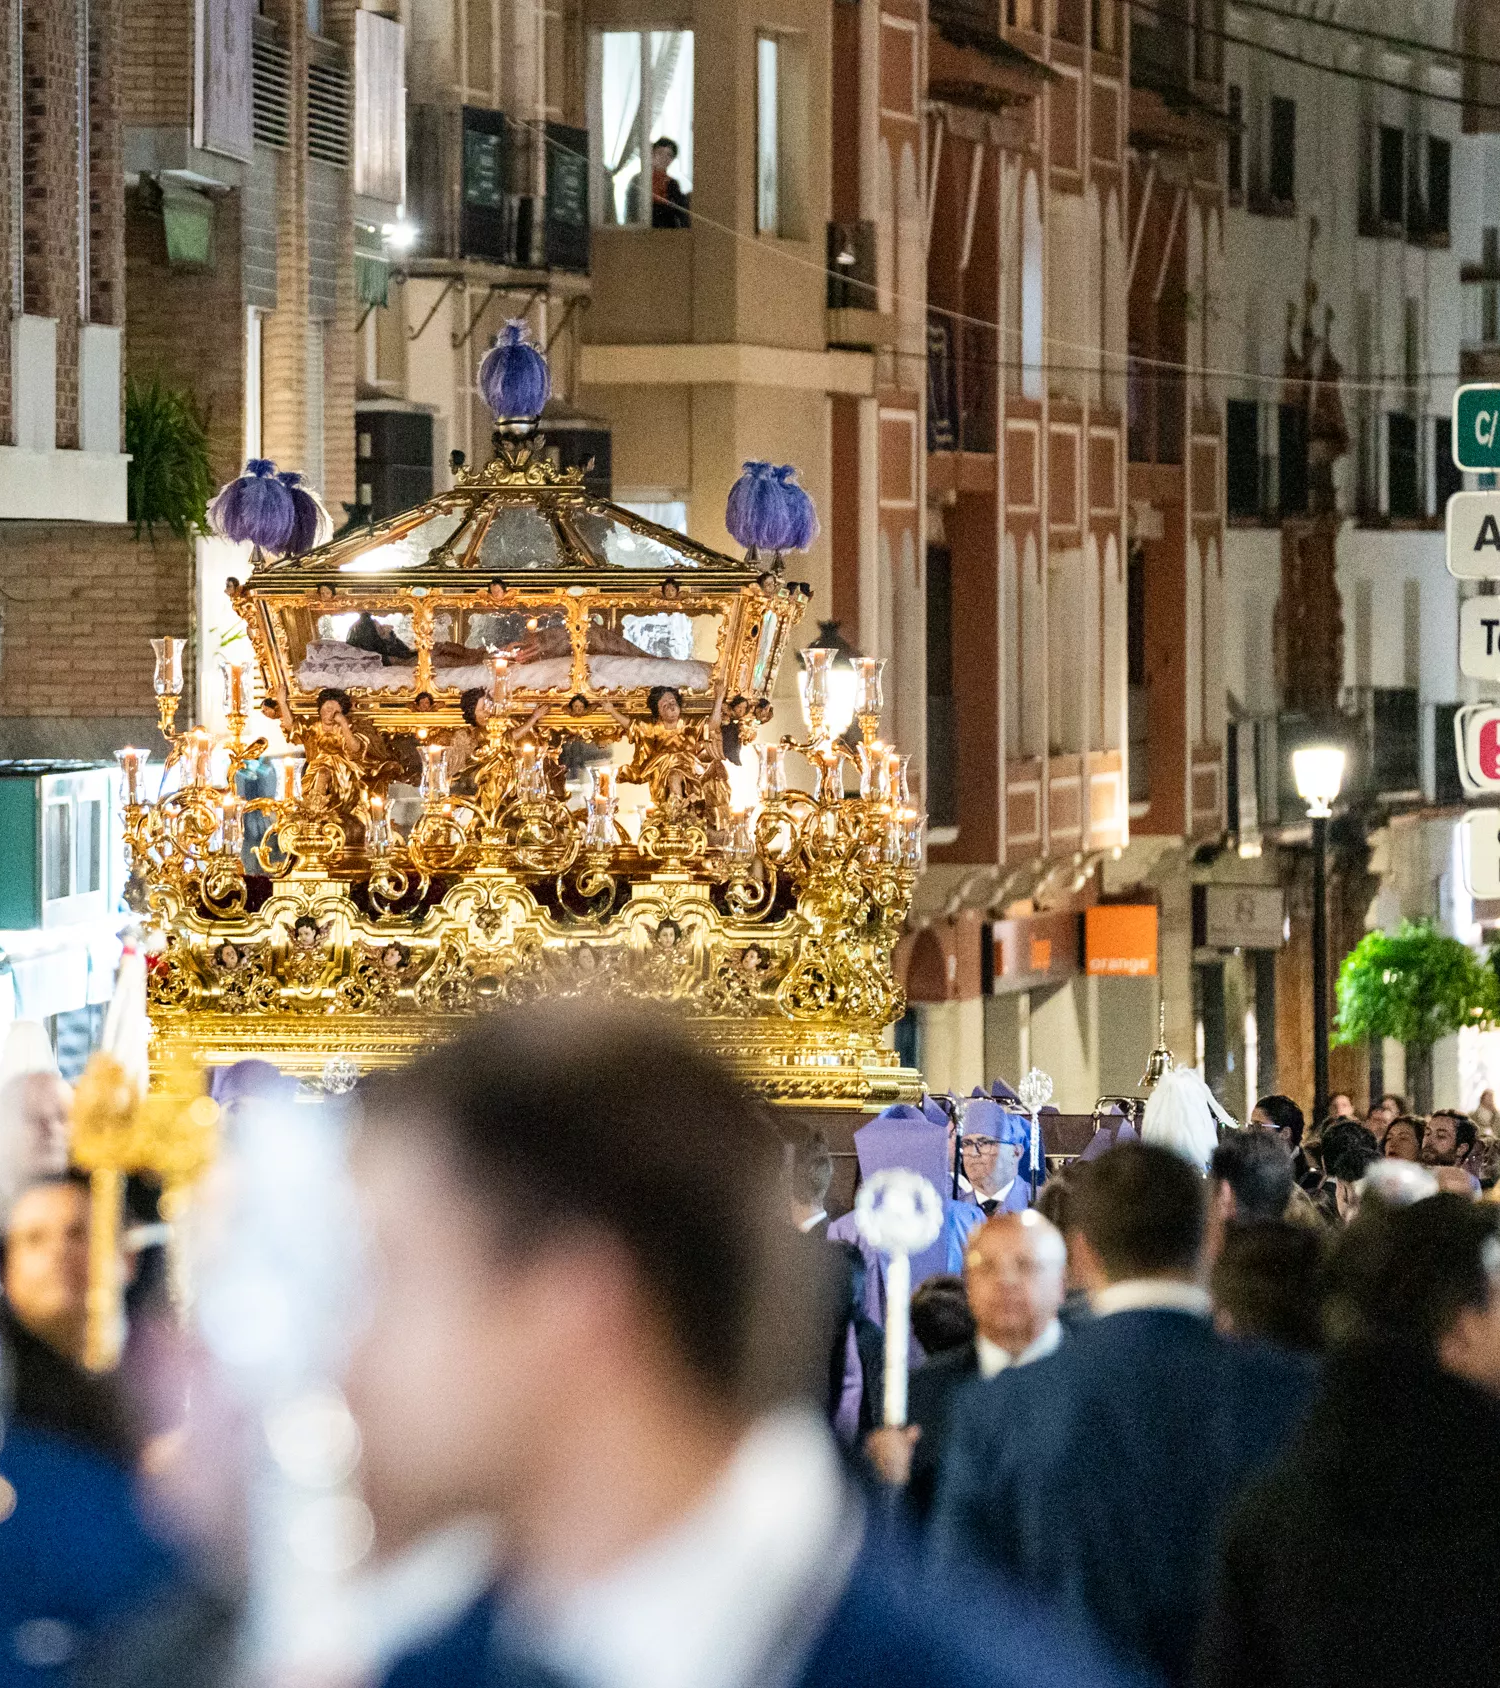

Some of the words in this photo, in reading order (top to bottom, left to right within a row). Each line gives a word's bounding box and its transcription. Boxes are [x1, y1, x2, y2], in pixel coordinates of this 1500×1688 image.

[1475, 410, 1499, 448] C/
[1480, 619, 1500, 656] T
[1089, 957, 1150, 976] orange
